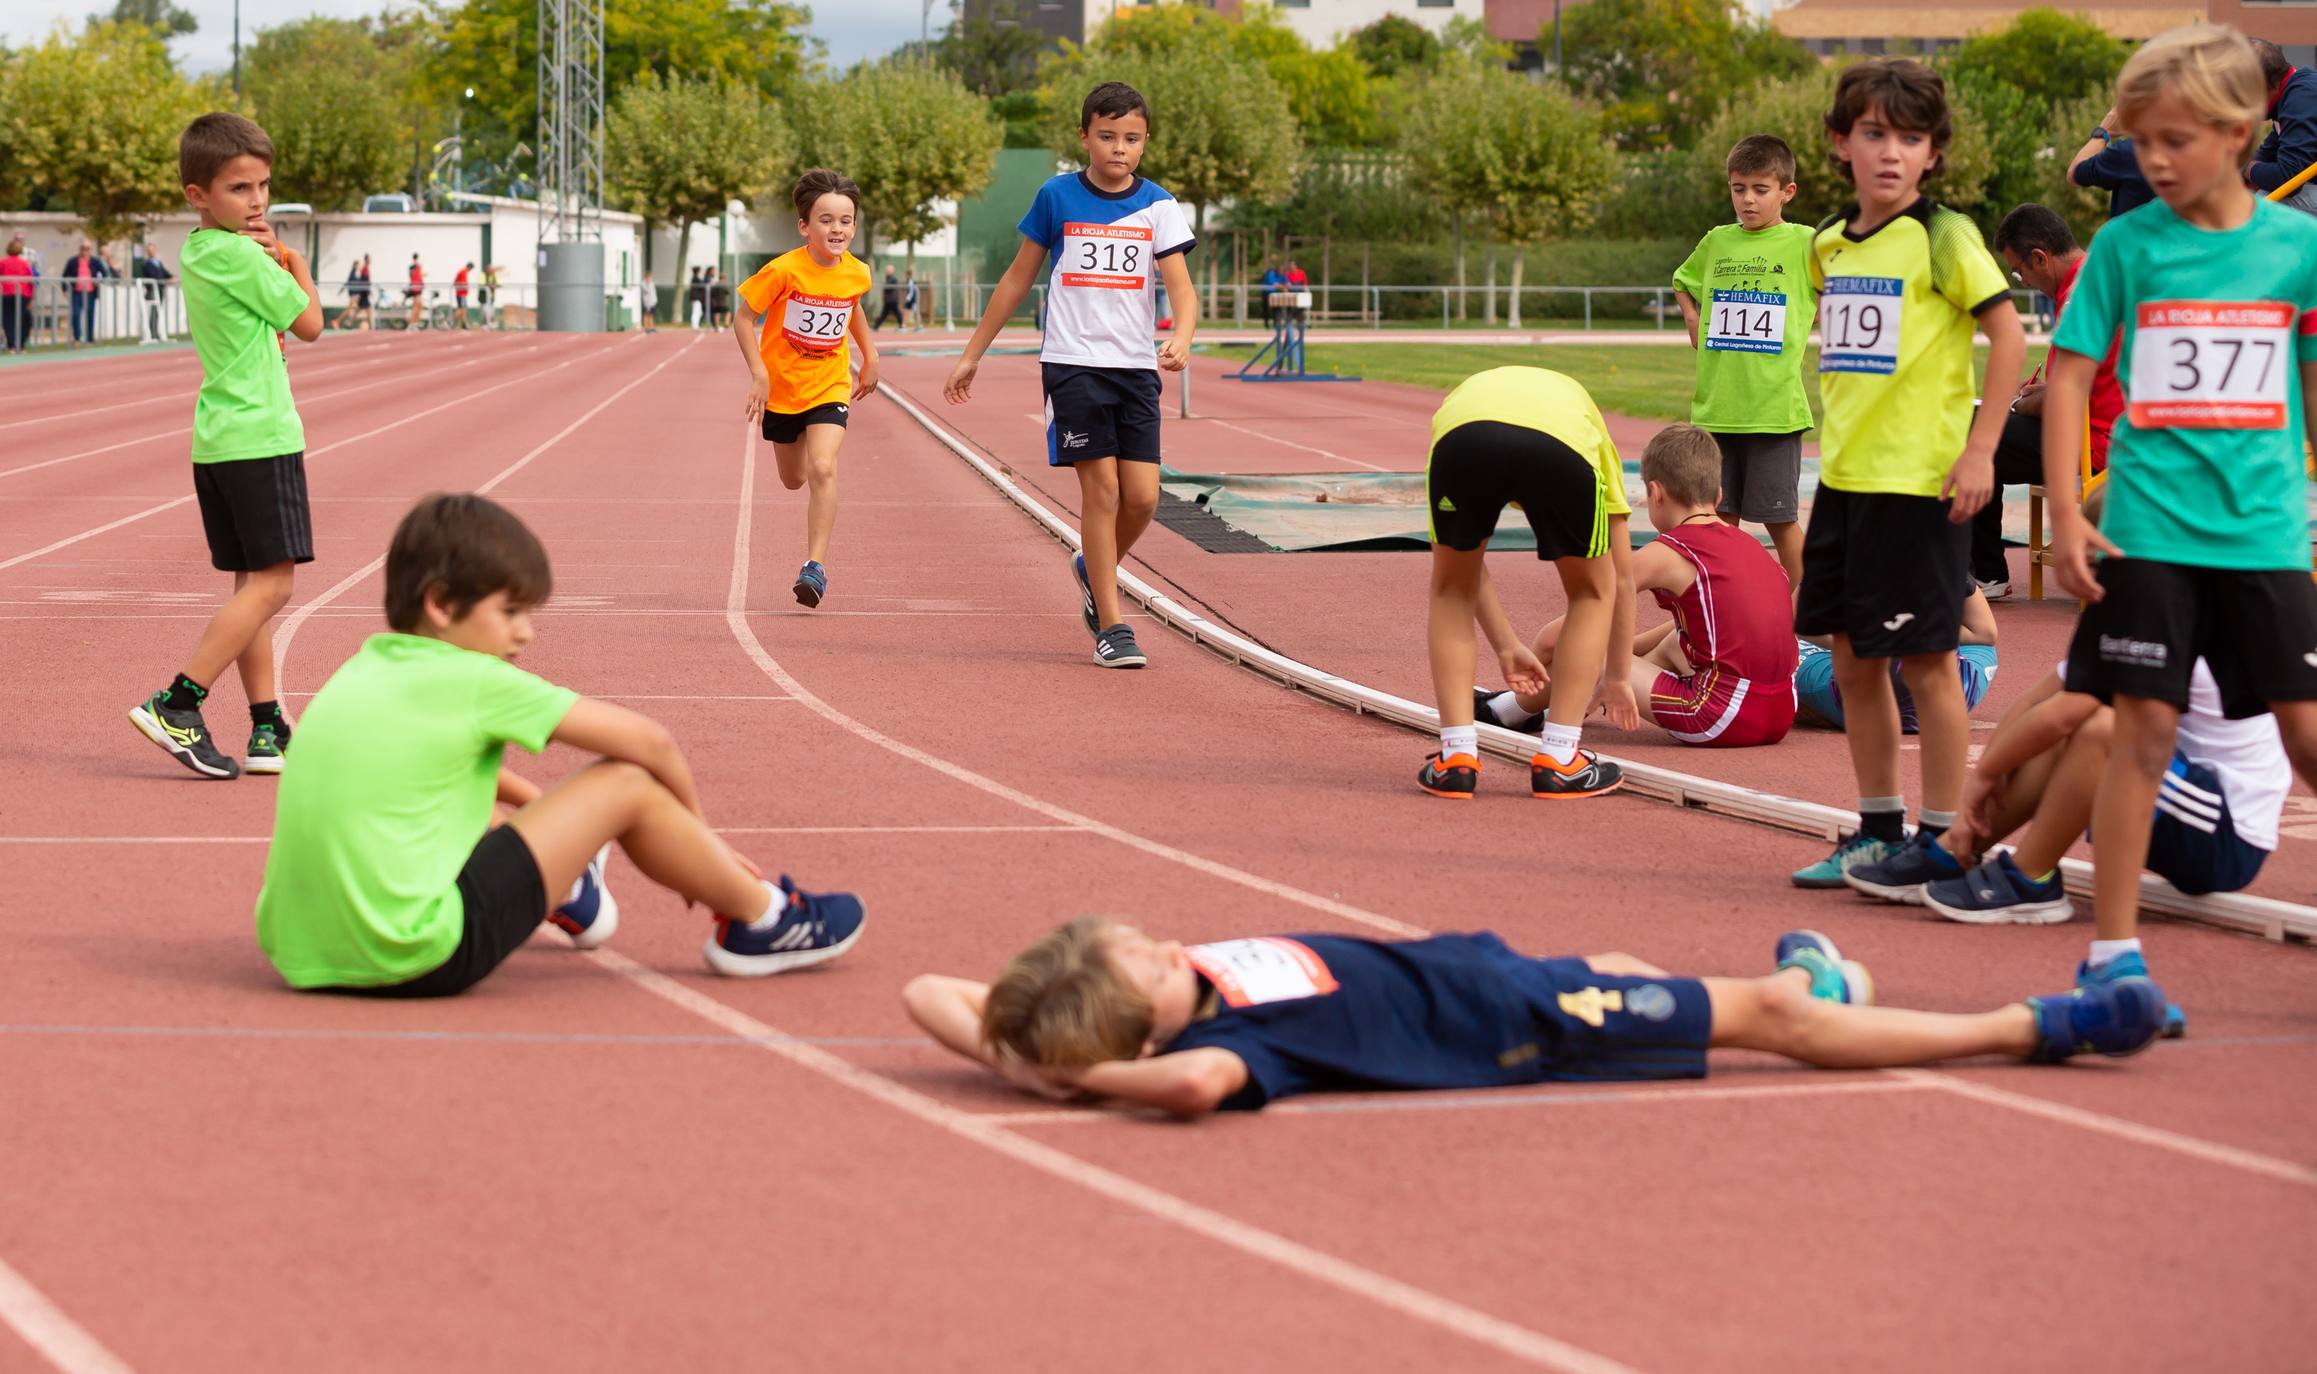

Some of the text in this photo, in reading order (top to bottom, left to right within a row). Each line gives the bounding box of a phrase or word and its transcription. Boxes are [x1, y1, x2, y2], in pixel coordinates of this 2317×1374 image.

[1082, 228, 1105, 236] RIOJA
[1107, 230, 1145, 238] ATLETISMO
[1080, 242, 1139, 273] 318
[1741, 264, 1767, 273] Familia
[795, 294, 803, 302] LA
[804, 298, 824, 306] RIOJA
[1730, 291, 1781, 304] HEMAFIX
[798, 310, 846, 335] 328
[1719, 308, 1772, 338] 114
[1825, 304, 1882, 348] 119
[2148, 310, 2166, 323] LA
[2167, 309, 2213, 324] RIOJA
[2169, 338, 2276, 393] 377
